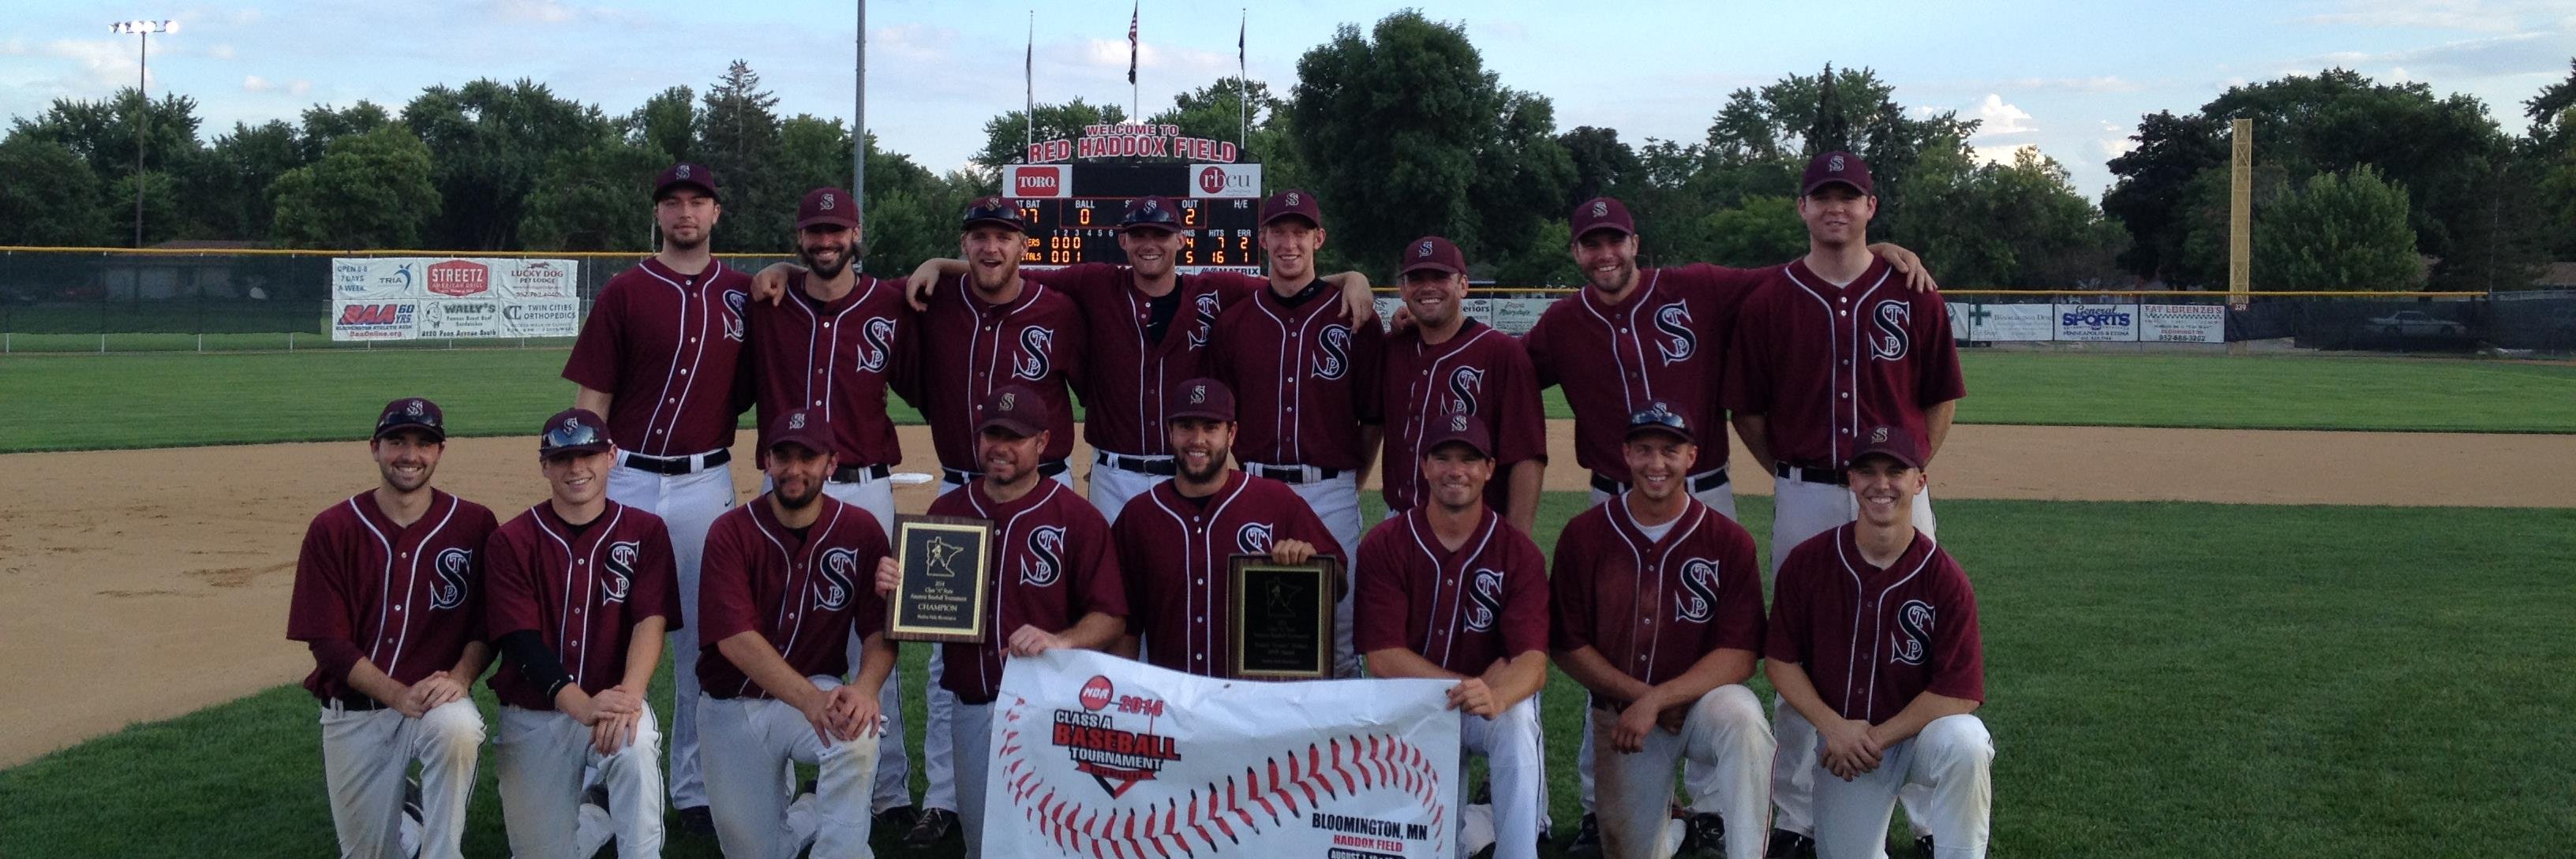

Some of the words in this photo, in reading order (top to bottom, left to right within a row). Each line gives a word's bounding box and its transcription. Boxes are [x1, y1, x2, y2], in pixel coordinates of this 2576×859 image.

[1085, 124, 1156, 136] WELCOME
[1160, 125, 1179, 136] TO
[1028, 140, 1071, 164] RED
[1078, 136, 1167, 158] HADDOX
[1174, 136, 1236, 163] FIELD
[1018, 176, 1055, 188] TORO
[1203, 169, 1250, 188] rbcu
[1075, 200, 1095, 208] BALL
[1181, 200, 1198, 208] OUT
[1234, 200, 1249, 209] H/E
[1080, 208, 1090, 224] 0
[1185, 208, 1195, 224] 2
[1186, 238, 1194, 248] 4
[1218, 237, 1224, 248] 7
[1240, 237, 1249, 249] 2
[1185, 251, 1193, 263] 5
[1211, 251, 1224, 263] 16
[432, 268, 483, 282] STREETZ
[444, 303, 496, 314] WALLY'S
[2076, 305, 2117, 315] General
[2166, 305, 2222, 314] LORENZO'S
[2062, 312, 2130, 327] SPORTS
[918, 603, 958, 612] CHAMPION
[1118, 695, 1163, 716] 2014
[1055, 710, 1099, 728] CLASS
[1101, 715, 1113, 729] A
[1052, 722, 1181, 761] BASEBALL
[1071, 747, 1163, 771] TOURNAMENT
[1312, 813, 1403, 840] BLOOMINGTON,
[1406, 824, 1428, 841] MN
[1333, 835, 1375, 849] HADDOX
[1377, 841, 1403, 852] FIELD
